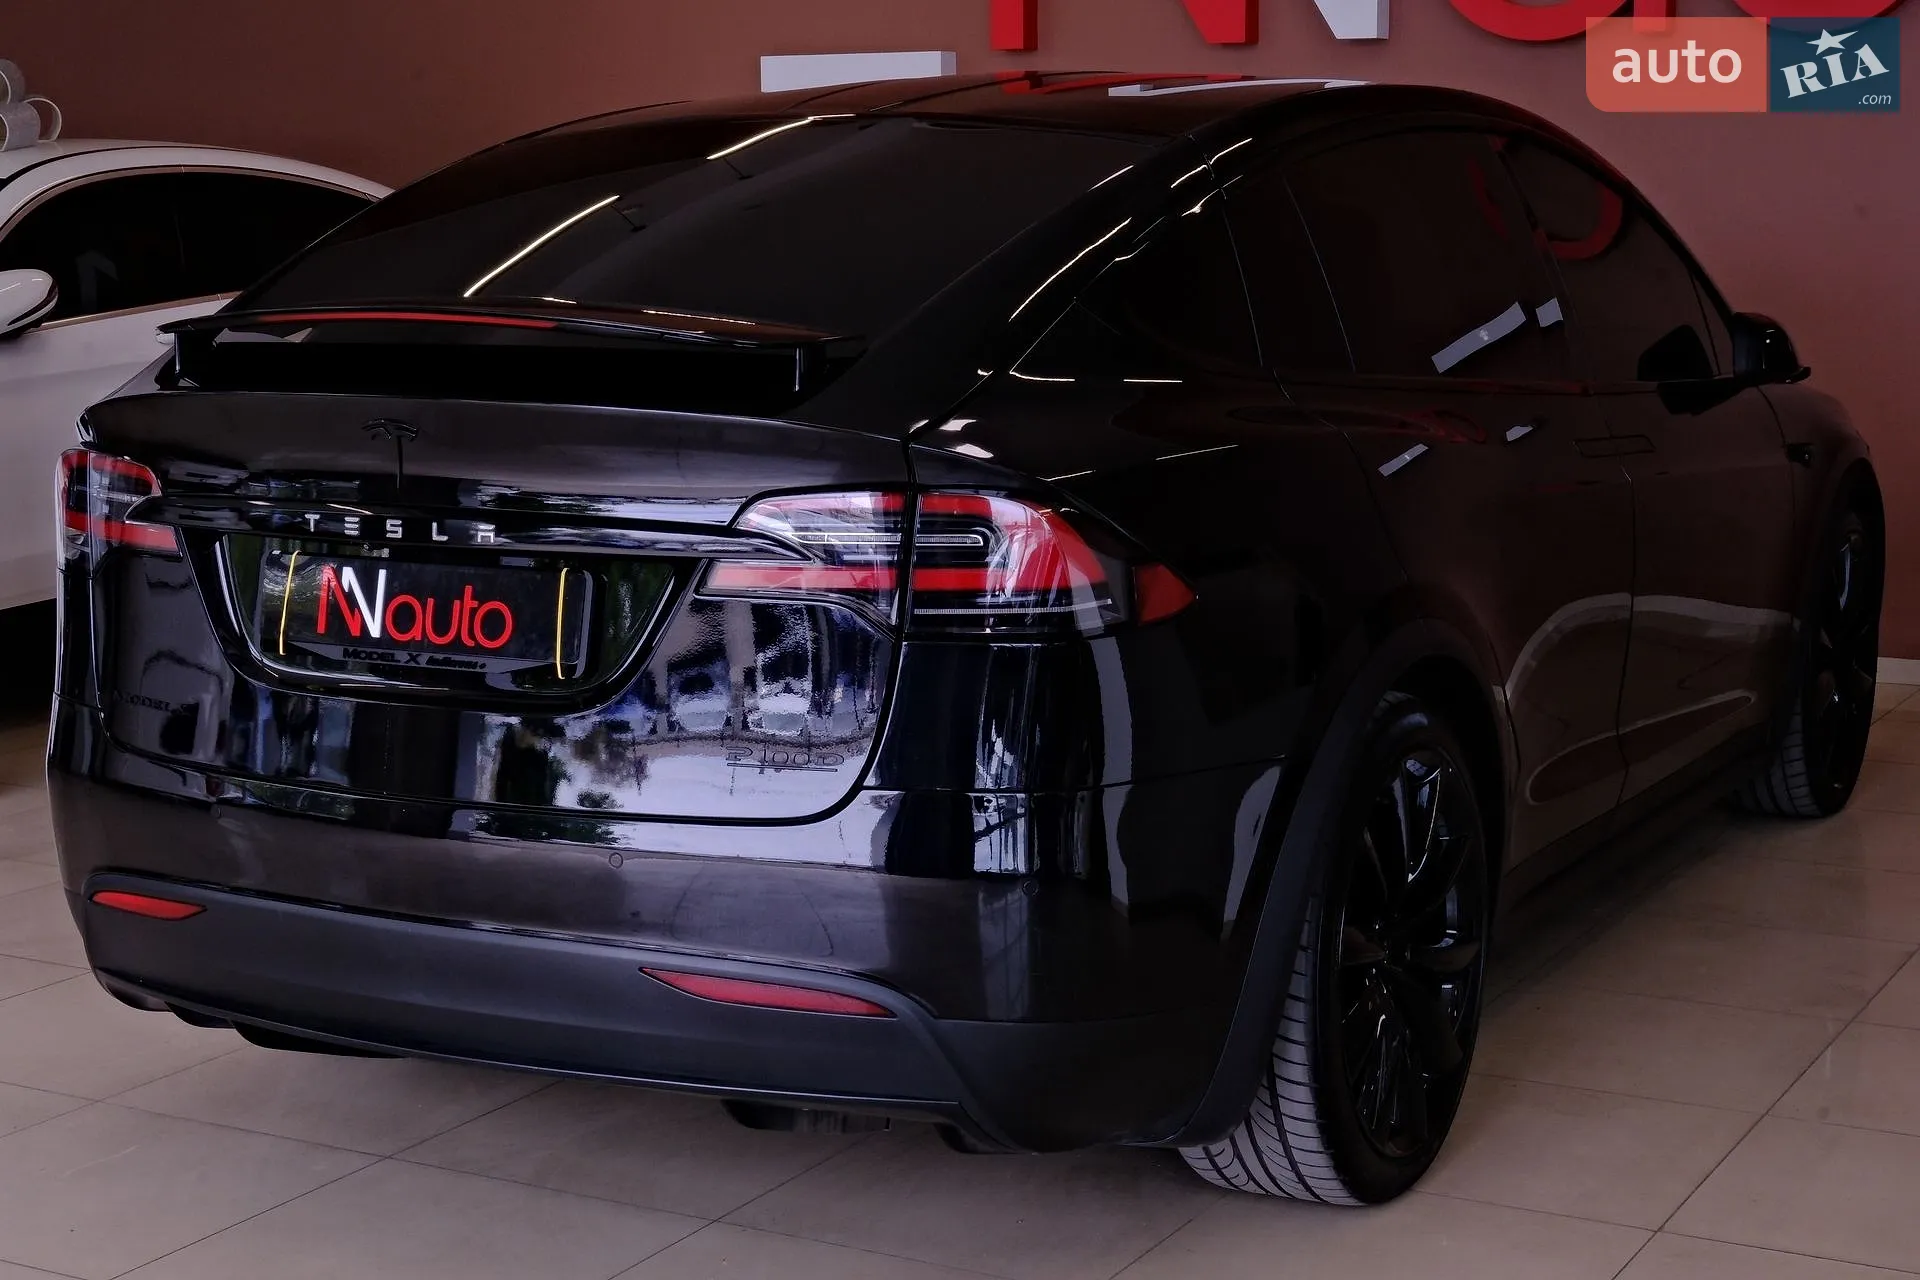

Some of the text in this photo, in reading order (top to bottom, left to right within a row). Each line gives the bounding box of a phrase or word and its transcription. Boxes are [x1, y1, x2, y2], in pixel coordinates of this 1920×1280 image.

[304, 513, 496, 543] TESLA
[342, 647, 401, 664] MODEL
[404, 652, 422, 666] X
[725, 746, 845, 767] P100D
